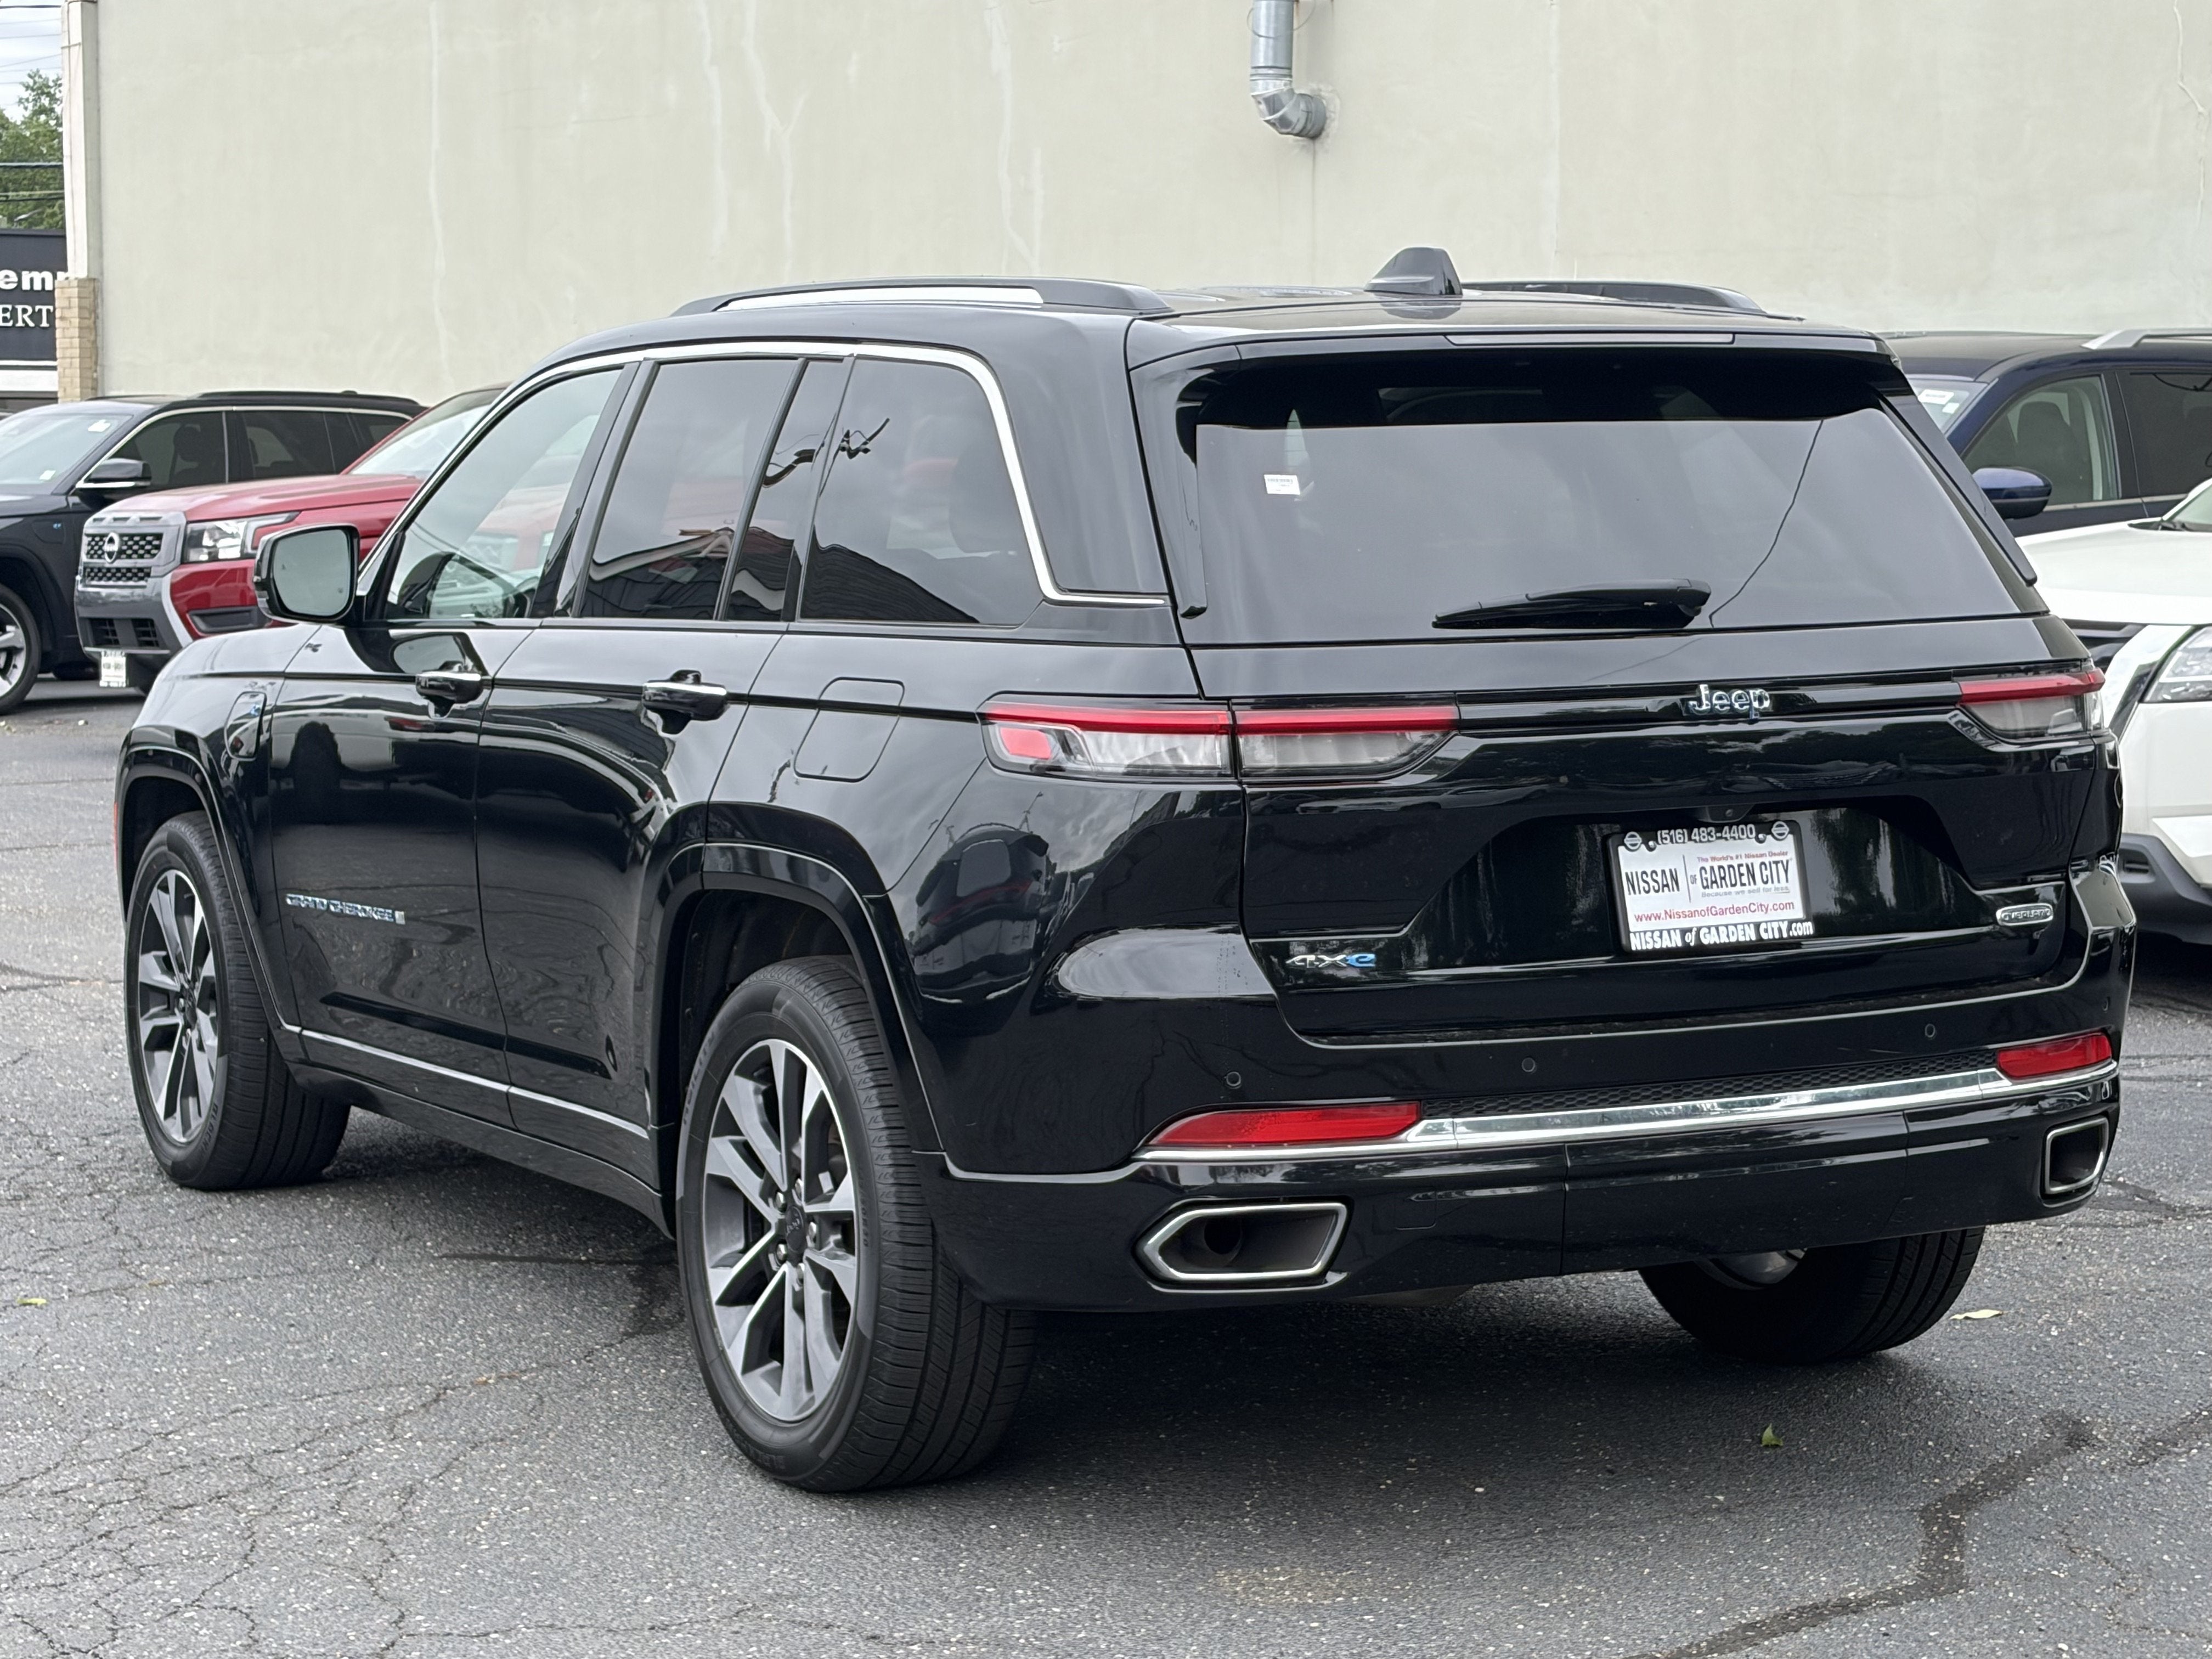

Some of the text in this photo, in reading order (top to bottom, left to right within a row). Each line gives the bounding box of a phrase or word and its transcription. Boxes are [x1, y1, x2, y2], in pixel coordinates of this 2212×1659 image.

[1688, 684, 1770, 719] Jeep
[1657, 823, 1756, 845] (516) 483-4400
[1625, 868, 1680, 895] NISSAN
[1699, 862, 1757, 889] GARDEN
[1759, 859, 1790, 885] CITY
[285, 894, 394, 922] GRAND CHEROKEE
[1634, 901, 1795, 922] www.NissanofGardenCity.com
[1629, 929, 1682, 951] NISSAN
[1685, 927, 1697, 946] of
[1700, 923, 1756, 945] GARDEN
